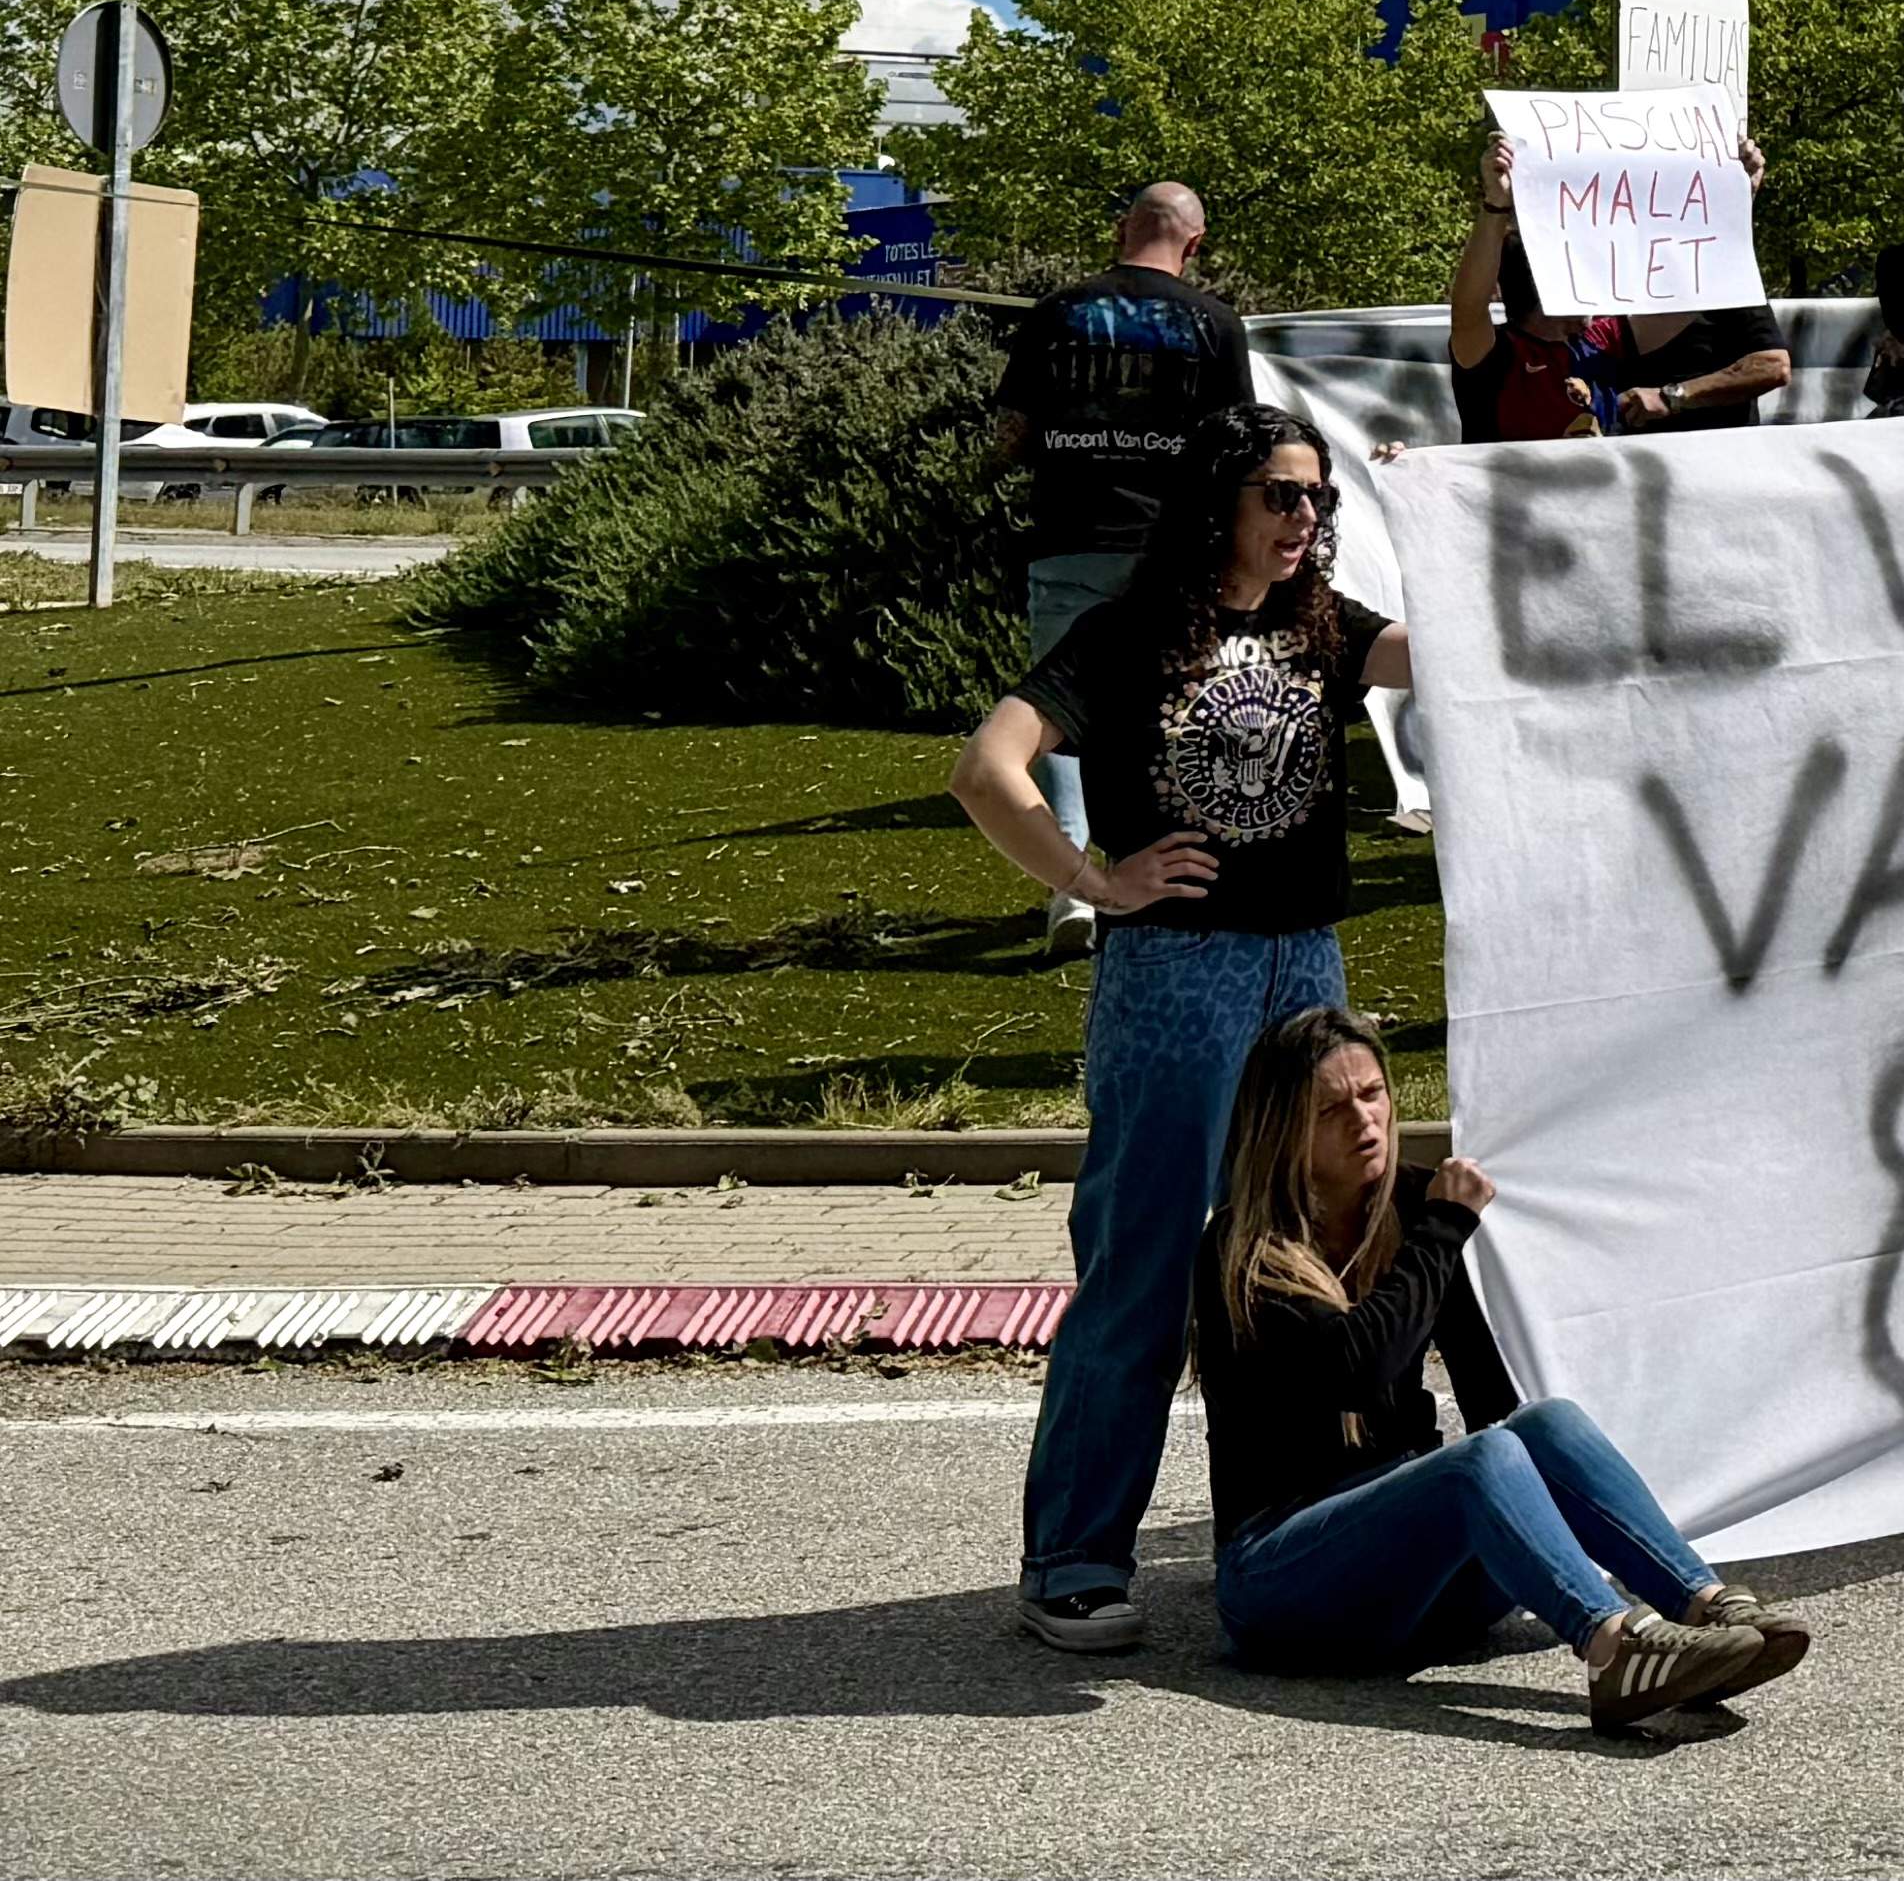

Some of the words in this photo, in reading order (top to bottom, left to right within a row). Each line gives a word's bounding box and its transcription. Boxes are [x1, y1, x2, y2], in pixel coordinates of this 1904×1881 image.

[1530, 98, 1740, 167] PASCUAL
[1560, 169, 1709, 229] MALA
[1565, 236, 1717, 305] LLET
[1488, 444, 1788, 688] EL
